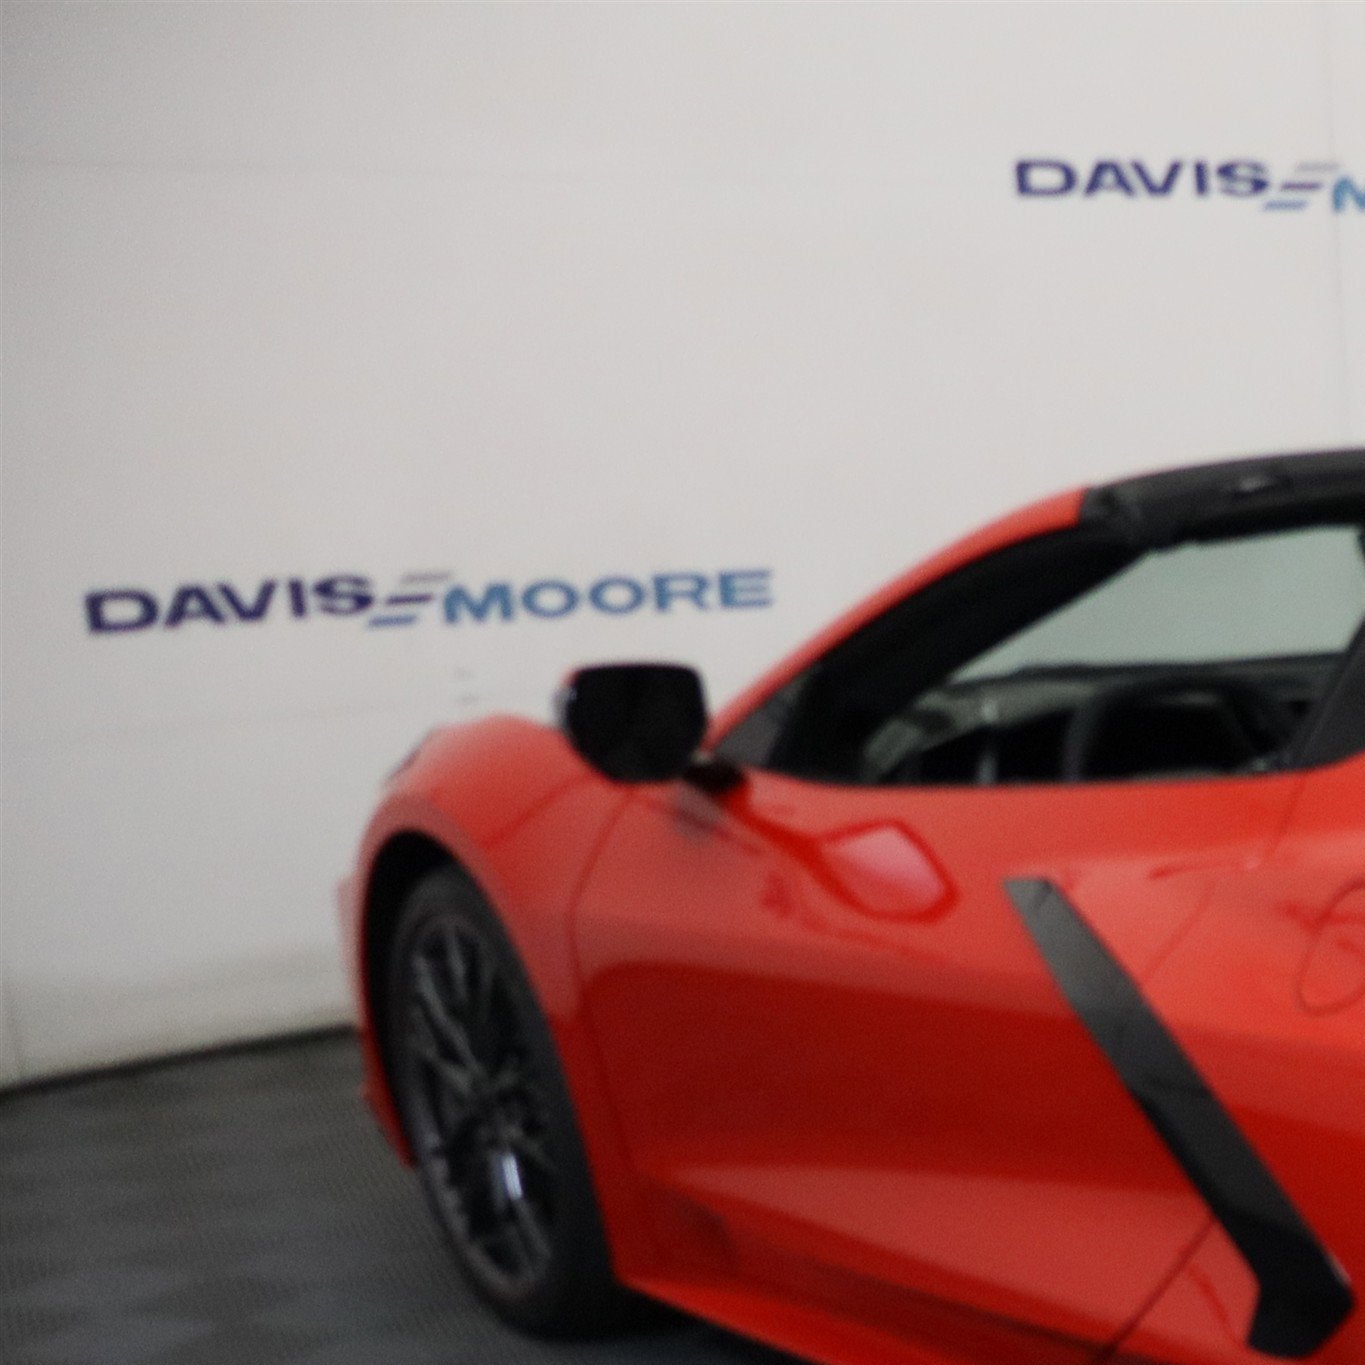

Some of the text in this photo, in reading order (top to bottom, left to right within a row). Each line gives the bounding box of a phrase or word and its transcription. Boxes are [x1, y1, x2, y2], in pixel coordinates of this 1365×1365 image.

[1013, 158, 1271, 198] DAVIS
[82, 569, 772, 636] DAVIS MOORE
